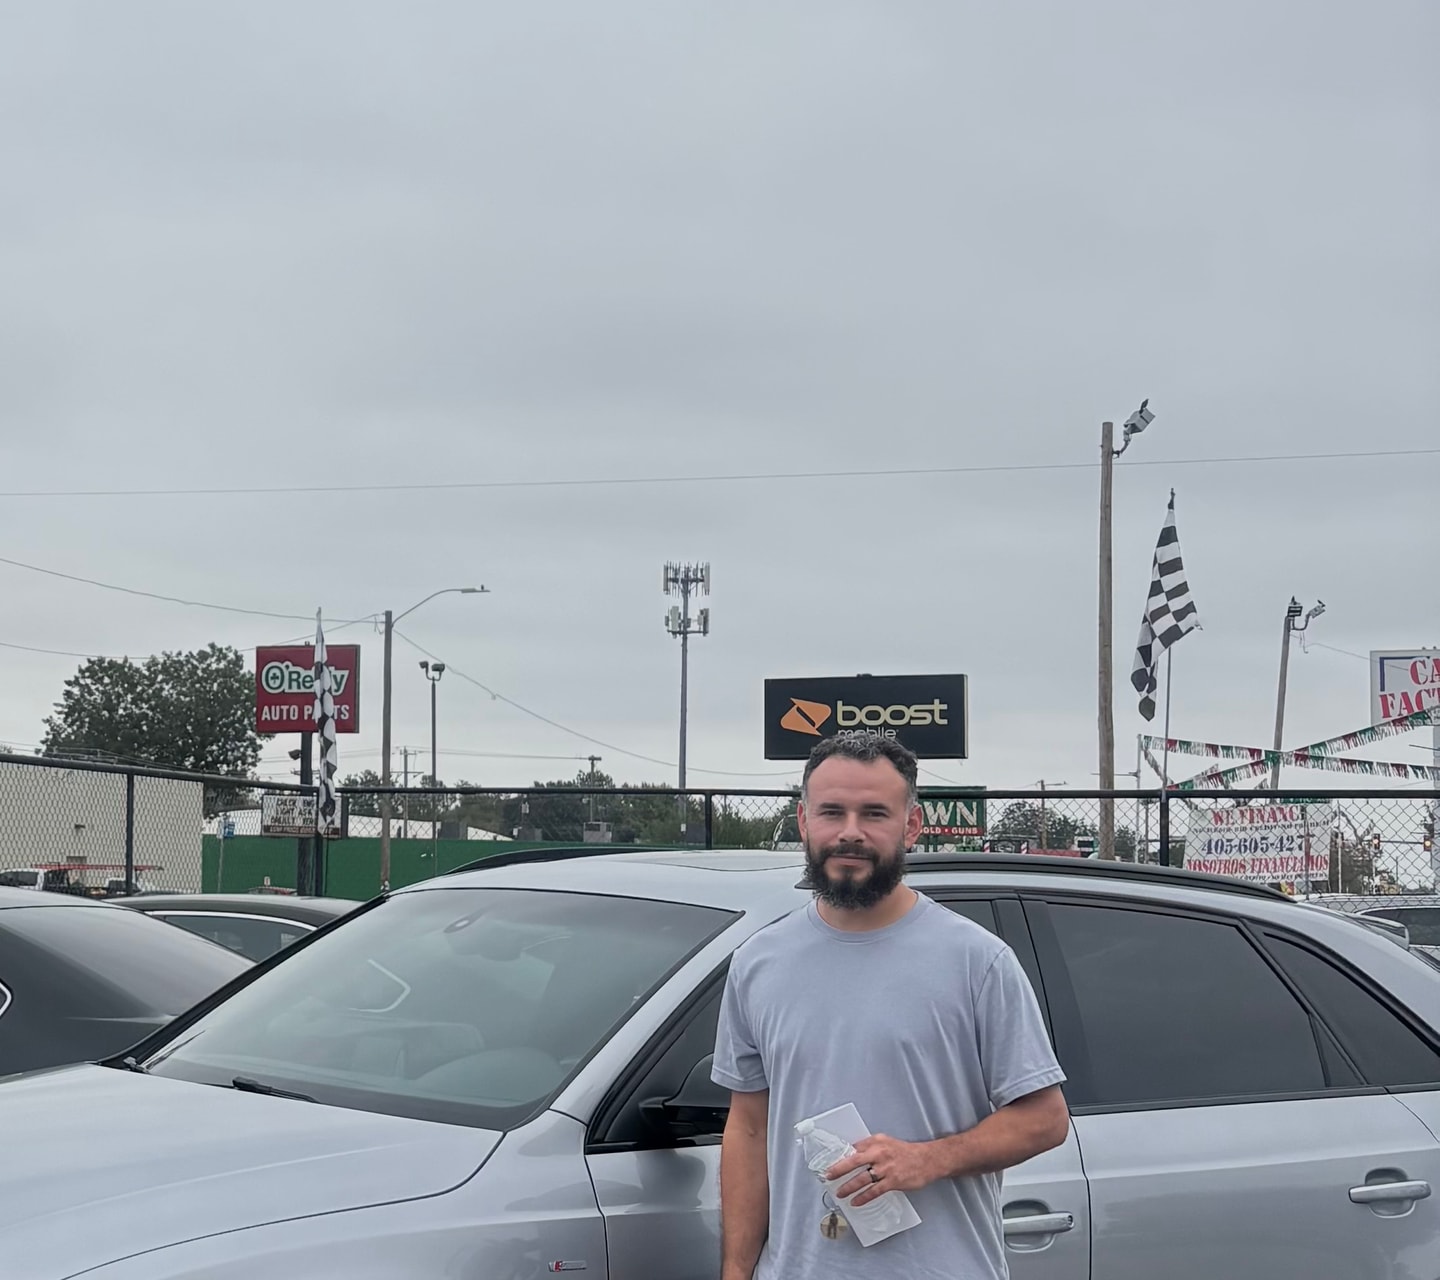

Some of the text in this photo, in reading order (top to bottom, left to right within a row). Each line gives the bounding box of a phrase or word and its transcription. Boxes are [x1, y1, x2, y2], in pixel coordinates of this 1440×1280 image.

[262, 661, 349, 696] O'Rey
[1410, 658, 1440, 686] CA
[261, 704, 350, 721] AUTO PTS
[836, 698, 948, 727] boost
[921, 801, 978, 826] WN
[1238, 805, 1306, 825] FINANC
[951, 826, 978, 835] GUNS
